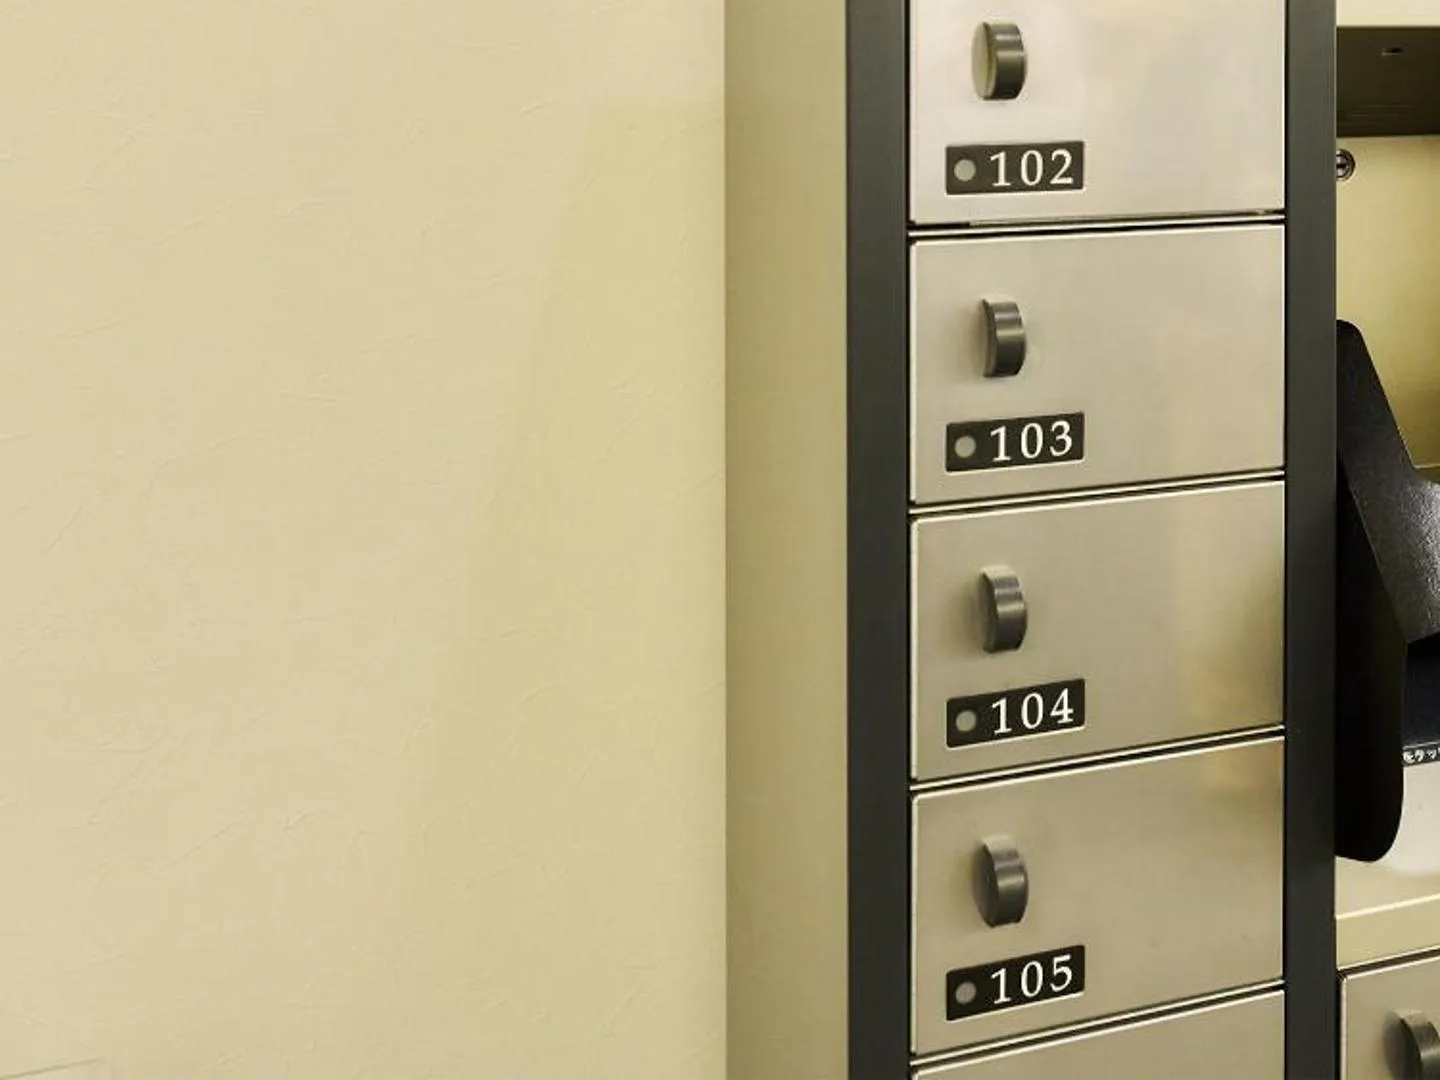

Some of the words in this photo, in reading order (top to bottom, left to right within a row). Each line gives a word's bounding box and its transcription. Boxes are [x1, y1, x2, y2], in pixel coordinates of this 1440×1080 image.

[990, 149, 1074, 186] 102
[990, 420, 1073, 462] 103
[991, 687, 1074, 736] 104
[990, 954, 1073, 1004] 105
